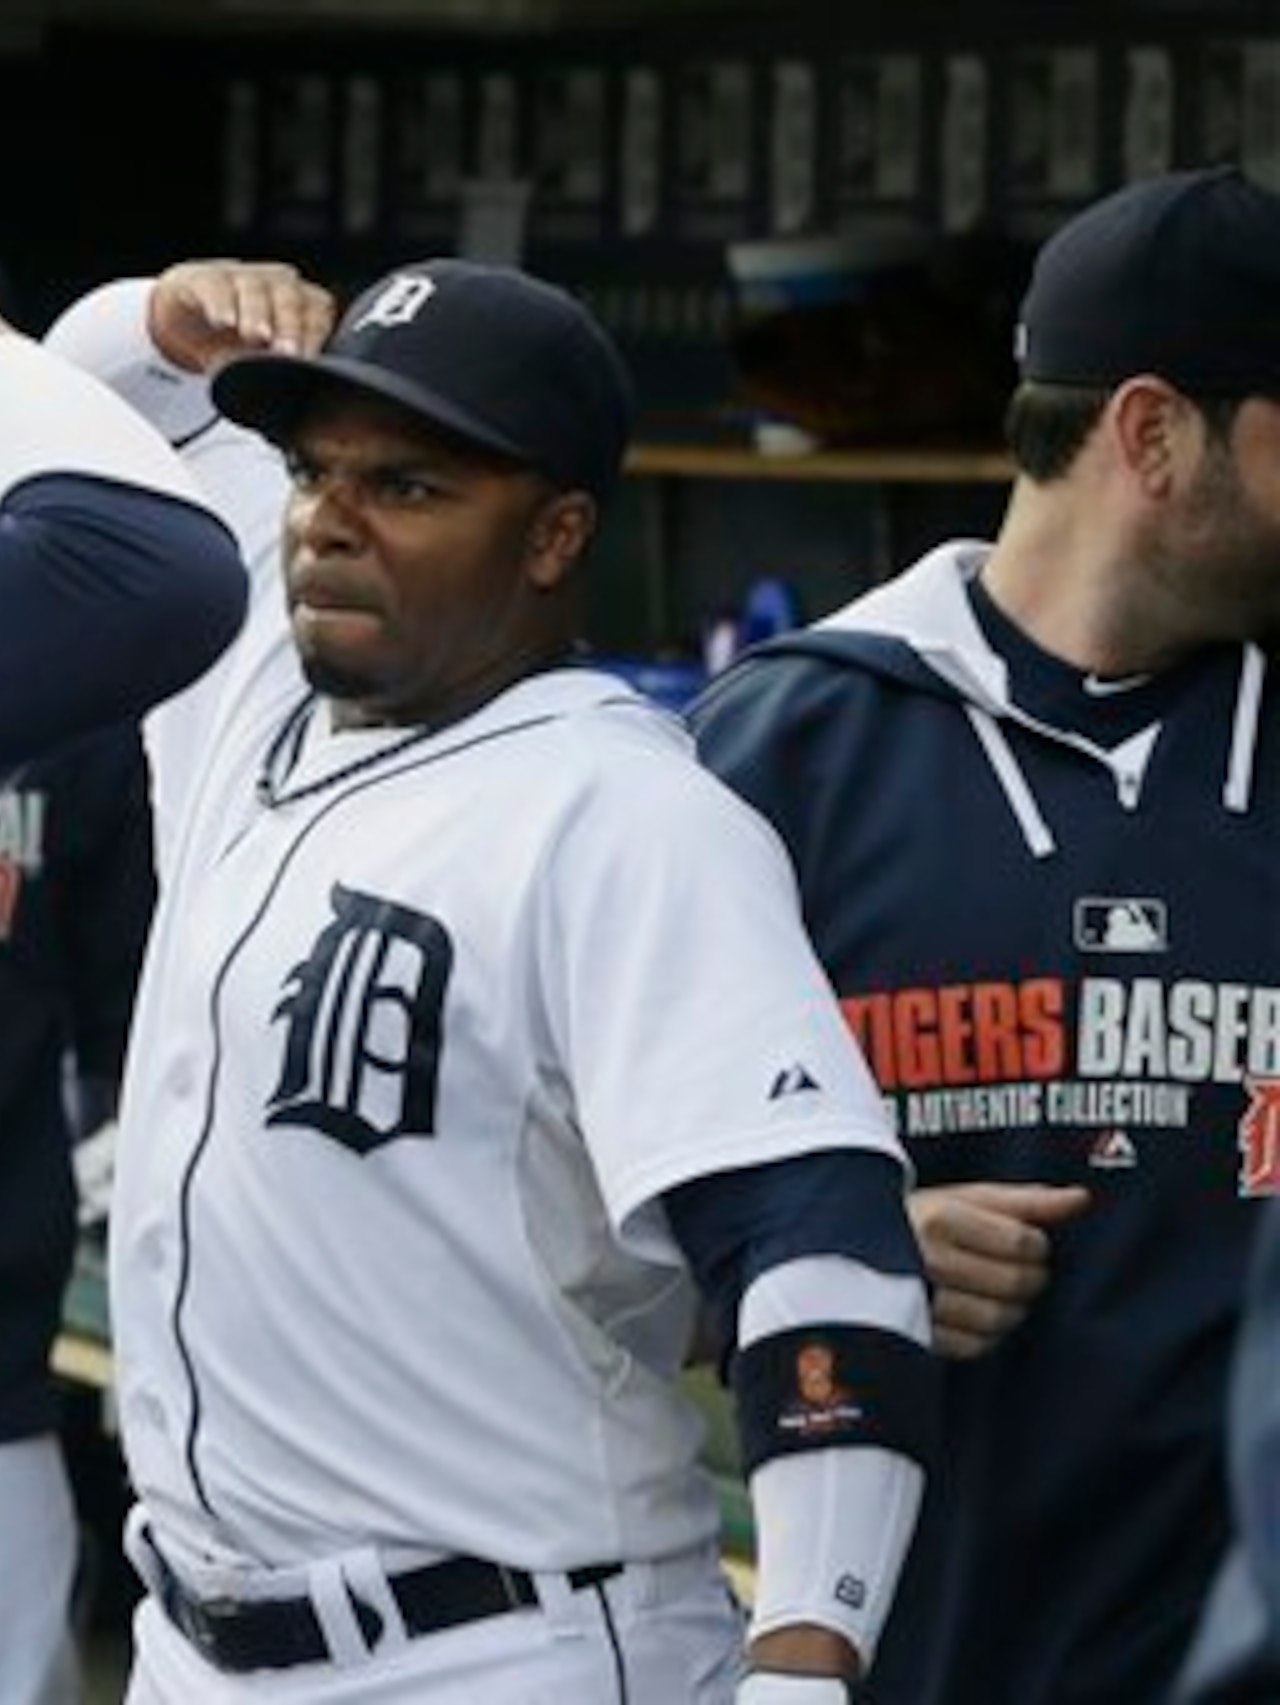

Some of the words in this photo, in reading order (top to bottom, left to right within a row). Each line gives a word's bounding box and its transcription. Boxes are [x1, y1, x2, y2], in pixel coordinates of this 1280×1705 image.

[264, 879, 456, 1159] D
[907, 1082, 1042, 1138] AUTHENTIC
[1046, 1080, 1189, 1128] COLLECTION
